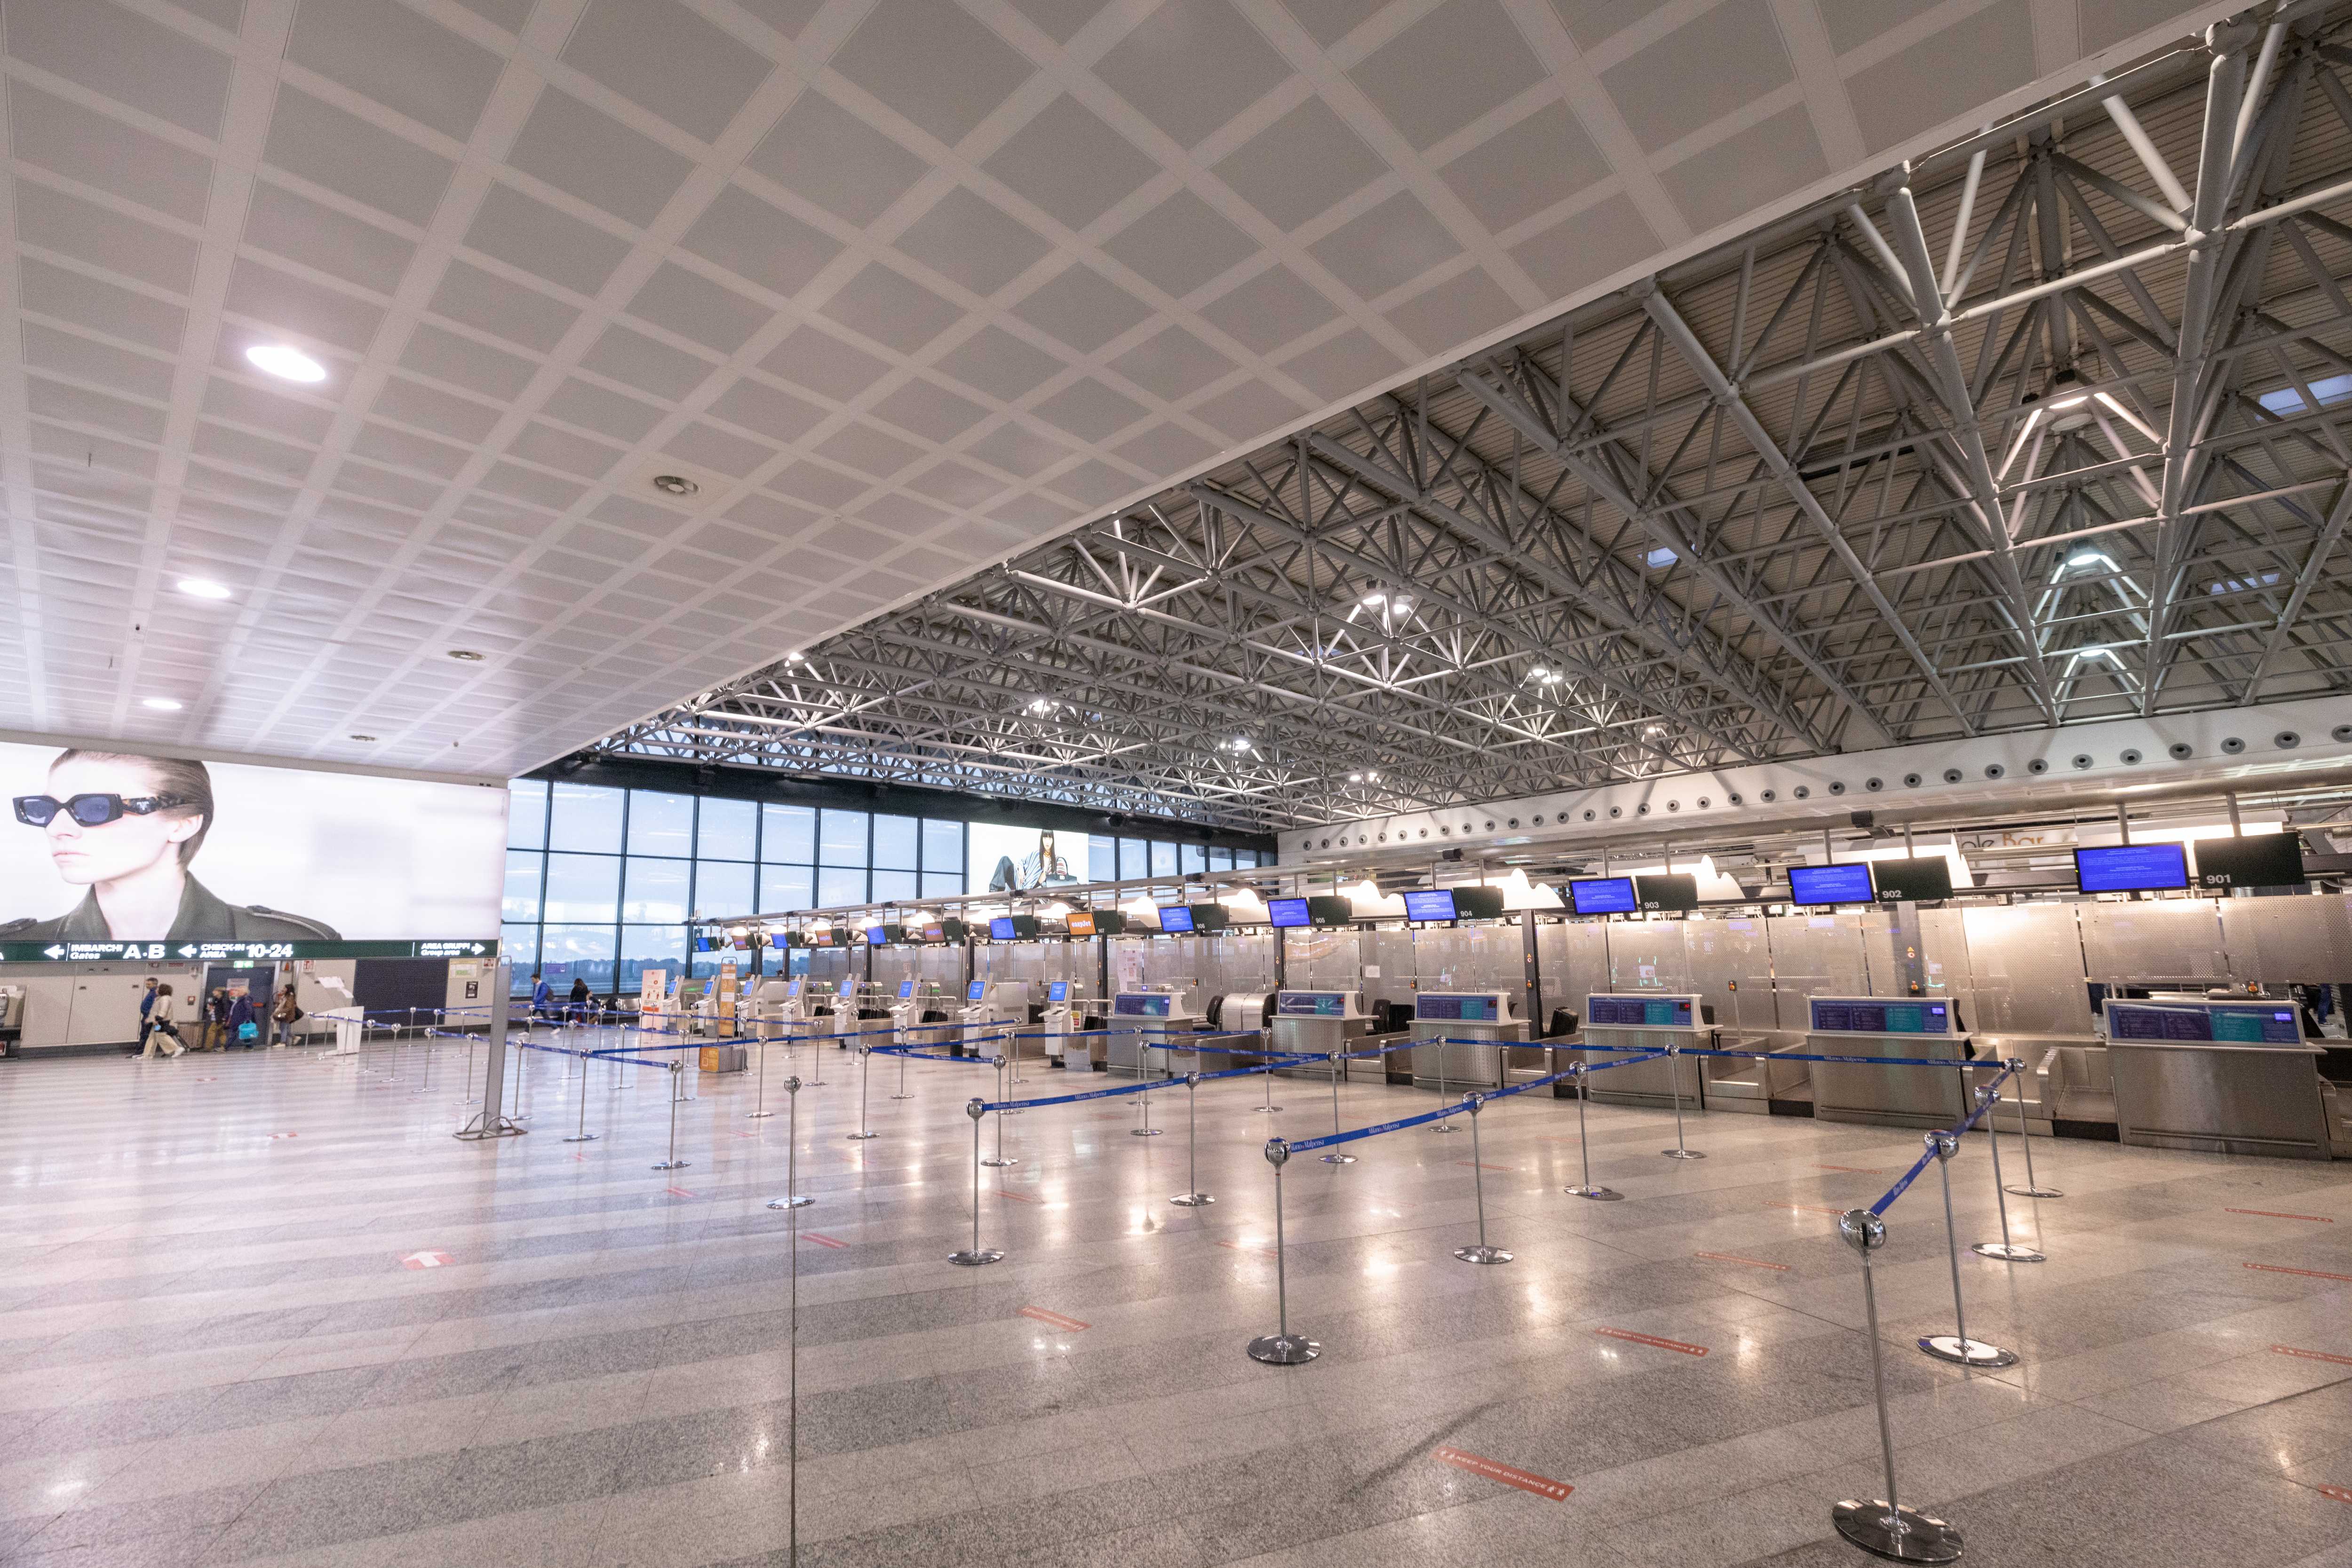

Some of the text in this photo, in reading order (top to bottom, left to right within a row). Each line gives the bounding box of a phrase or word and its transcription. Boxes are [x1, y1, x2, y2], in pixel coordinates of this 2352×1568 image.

[2206, 874, 2231, 884] 901
[1883, 890, 1902, 898] 902
[246, 943, 294, 958] 10-24
[1089, 1091, 1107, 1100] Malpensa
[1009, 1101, 1030, 1109] Malpensa
[1448, 1105, 1463, 1115] Malpensa
[1383, 1122, 1400, 1132] Malpensa
[1303, 1139, 1325, 1149] Malpensa
[1456, 1456, 1547, 1489] KEEP YOUR DISTANCE
